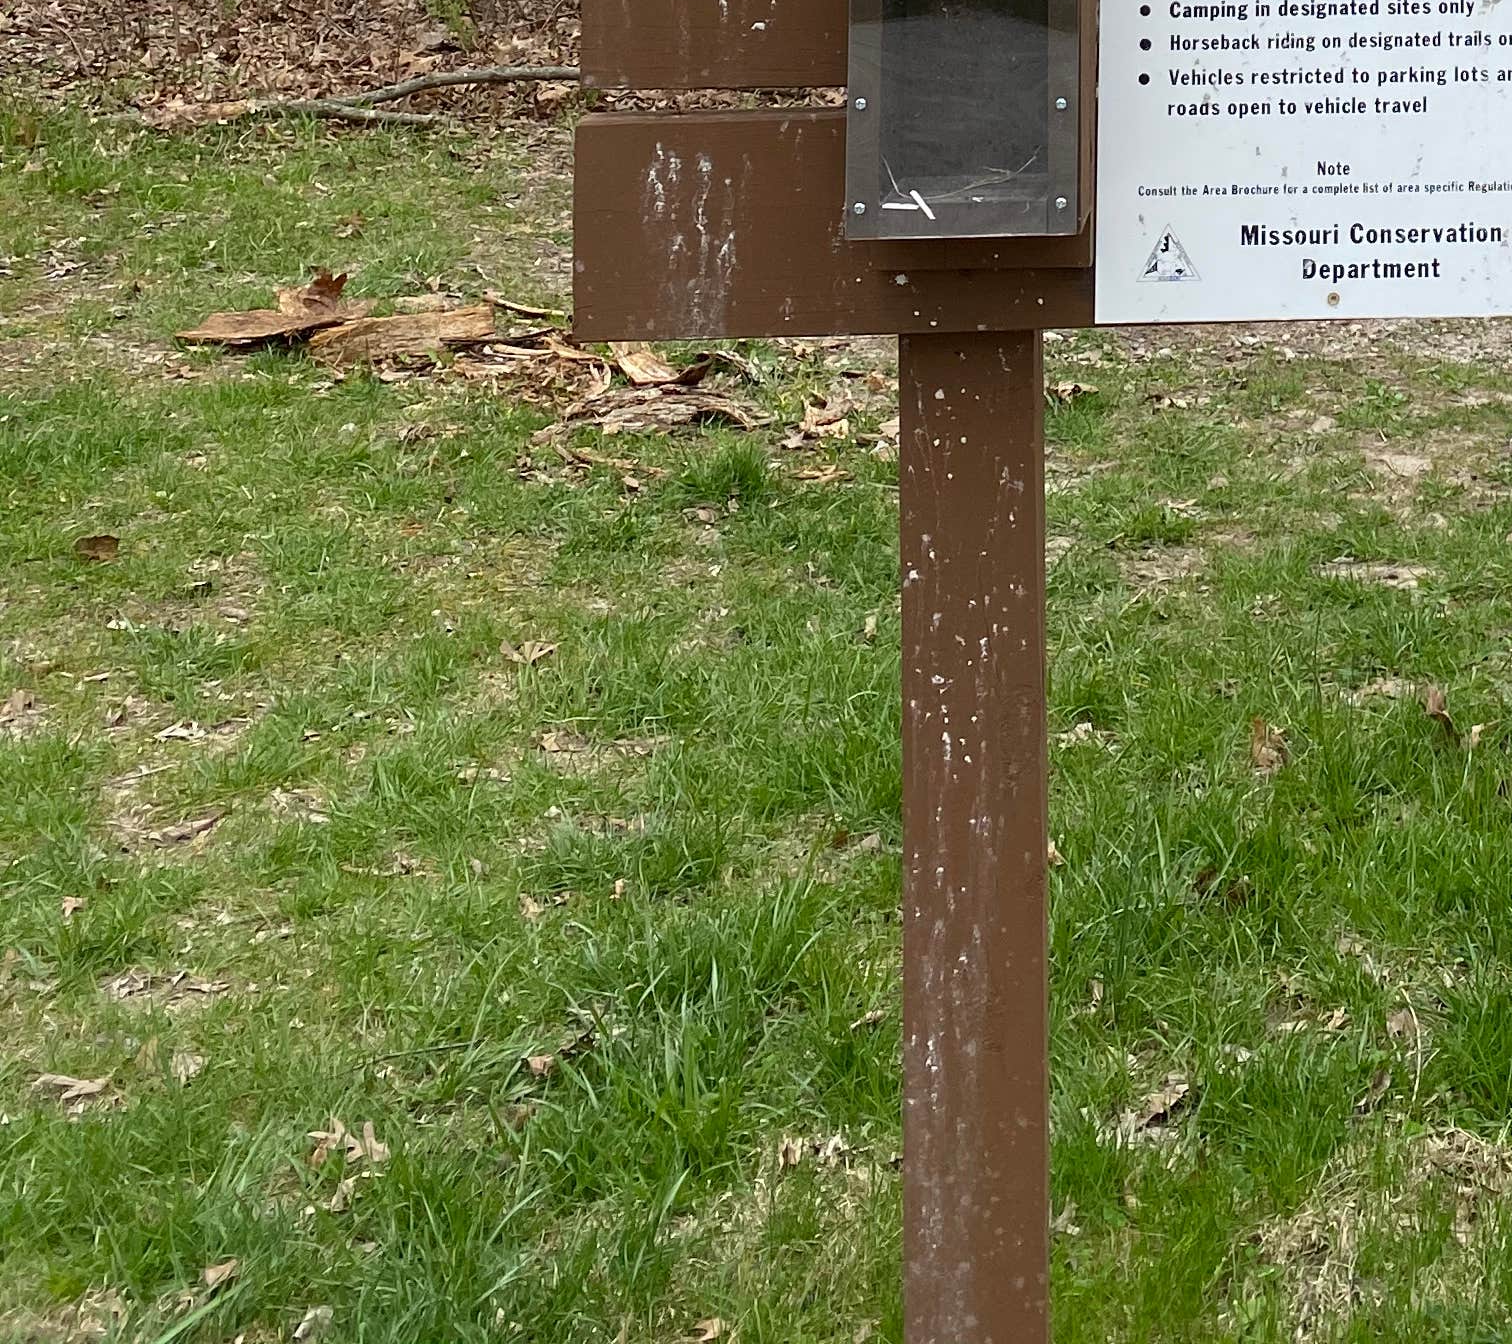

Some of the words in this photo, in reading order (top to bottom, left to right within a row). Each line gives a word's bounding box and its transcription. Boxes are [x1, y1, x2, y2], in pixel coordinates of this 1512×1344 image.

[1170, 1, 1248, 21] Camping
[1256, 0, 1269, 16] in
[1279, 0, 1378, 19] designated
[1171, 34, 1259, 50] Horseback
[1268, 33, 1315, 51] riding
[1322, 37, 1340, 48] on
[1349, 32, 1440, 50] designated
[1448, 31, 1491, 46] trails
[1169, 69, 1243, 85] Vehicles
[1252, 68, 1343, 84] restricted
[1352, 68, 1369, 83] to
[1378, 66, 1446, 86] parking
[1455, 67, 1488, 81] lots
[1168, 103, 1219, 115] roads
[1228, 103, 1270, 118] open
[1279, 99, 1296, 114] to
[1305, 97, 1366, 113] vehicle
[1375, 96, 1426, 113] travel
[1318, 161, 1350, 175] Note
[1139, 186, 1176, 196] Consult
[1182, 186, 1197, 195] the
[1203, 185, 1227, 195] Area
[1232, 185, 1279, 194] Brochure
[1284, 184, 1298, 194] for
[1312, 183, 1359, 195] complete
[1363, 183, 1378, 193] list
[1383, 183, 1392, 192] of
[1425, 181, 1463, 194] specific
[1241, 224, 1338, 245] Missouri
[1350, 222, 1501, 244] Conservation
[1303, 258, 1440, 283] Department
